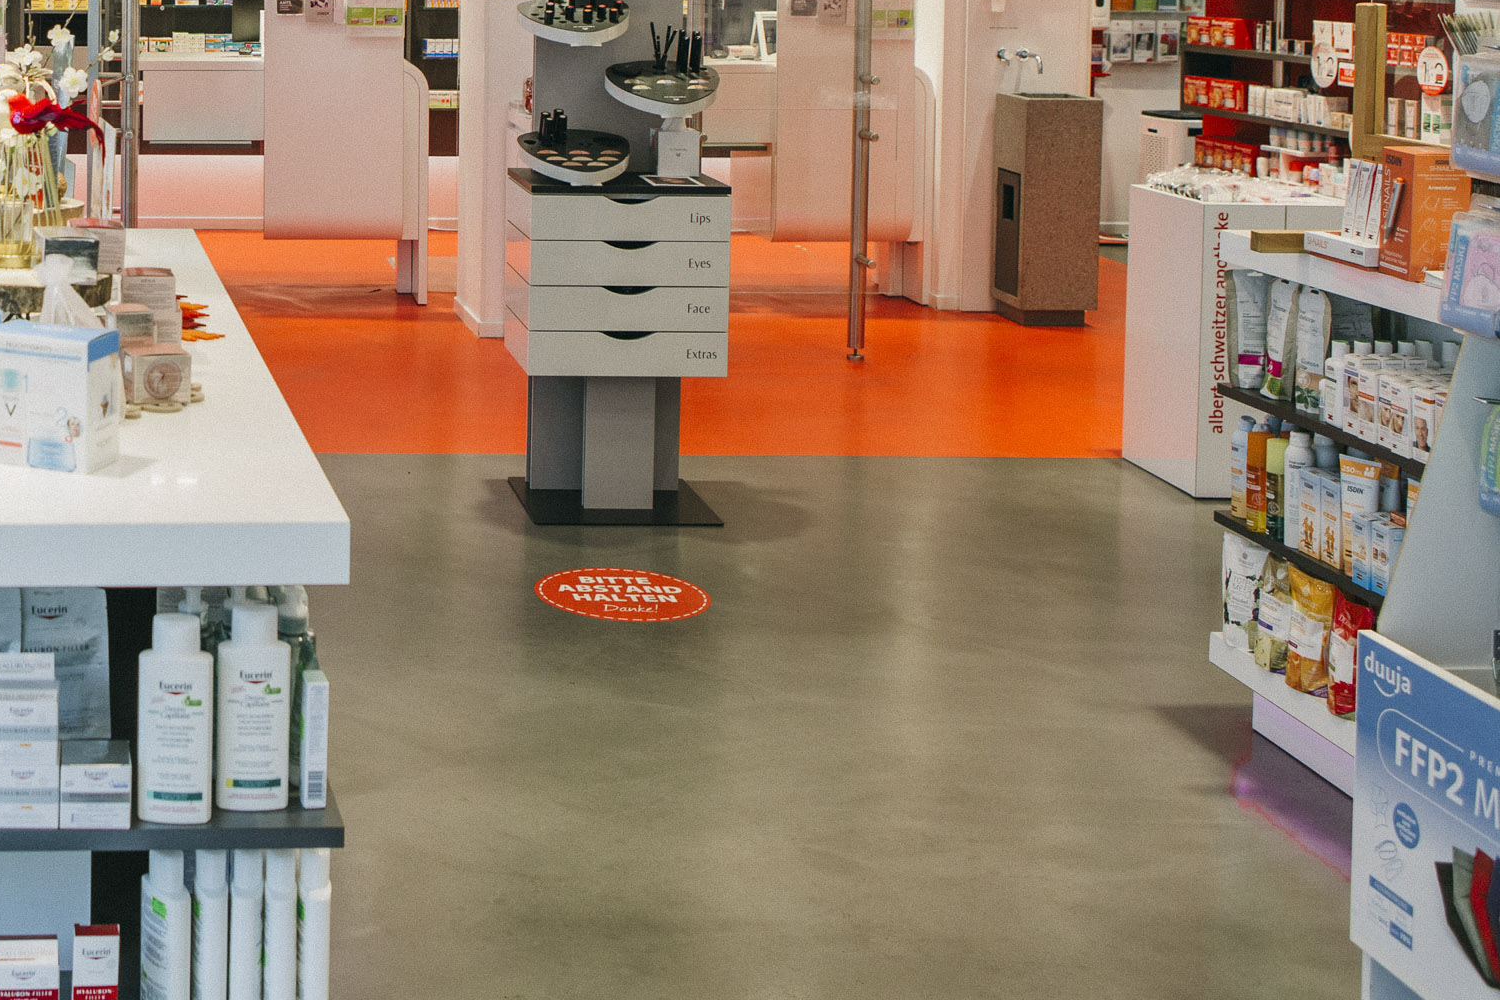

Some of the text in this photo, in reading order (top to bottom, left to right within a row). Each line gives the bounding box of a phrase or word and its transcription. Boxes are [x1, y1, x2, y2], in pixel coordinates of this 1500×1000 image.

[690, 212, 711, 226] Lips
[688, 258, 711, 271] Eyes
[687, 303, 711, 314] Face
[1210, 293, 1227, 381] schweitzer
[686, 349, 718, 360] Extras
[1347, 485, 1364, 495] ISDIN
[578, 576, 652, 585] BITTE
[558, 584, 683, 595] ABSTAND
[572, 593, 678, 603] HALTEN
[31, 604, 68, 614] Eucerin
[603, 603, 659, 613] Danke!
[240, 671, 272, 679] Eucerin
[1364, 650, 1412, 696] duuja
[159, 682, 192, 691] Eucerin
[1395, 728, 1464, 806] FFP2
[82, 948, 111, 956] Eucerin
